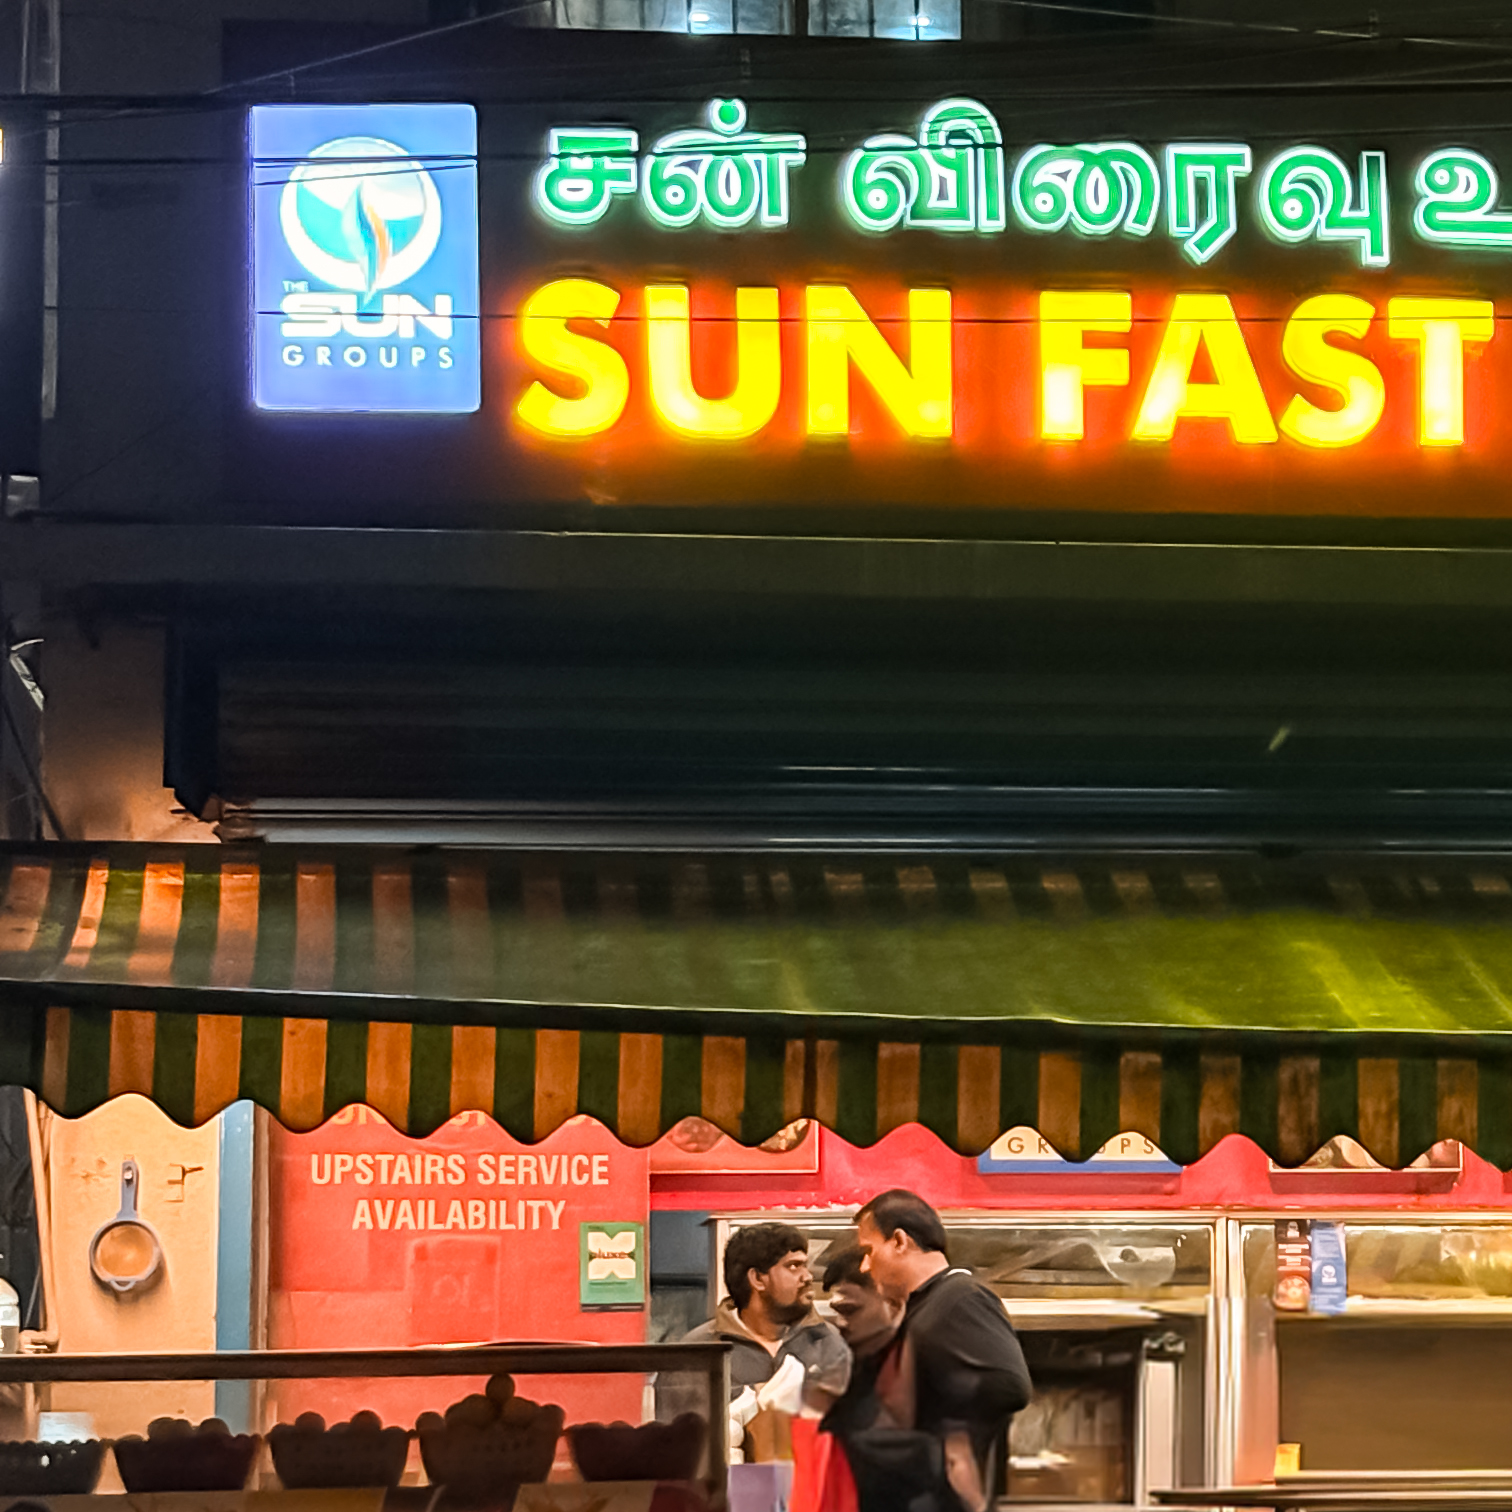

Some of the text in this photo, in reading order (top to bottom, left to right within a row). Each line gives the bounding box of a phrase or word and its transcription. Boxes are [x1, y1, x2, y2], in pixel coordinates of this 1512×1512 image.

[537, 98, 807, 228] சன்
[843, 97, 1391, 266] விரைவு
[282, 280, 309, 293] THE
[280, 293, 453, 340] SUN
[282, 344, 454, 369] GROUPS
[516, 278, 953, 440] SUN
[1039, 291, 1495, 448] FAST
[1007, 1136, 1154, 1155] GRPS
[310, 1154, 610, 1185] UPSTAIRS SERVICE
[352, 1199, 566, 1230] AVAILABILITY
